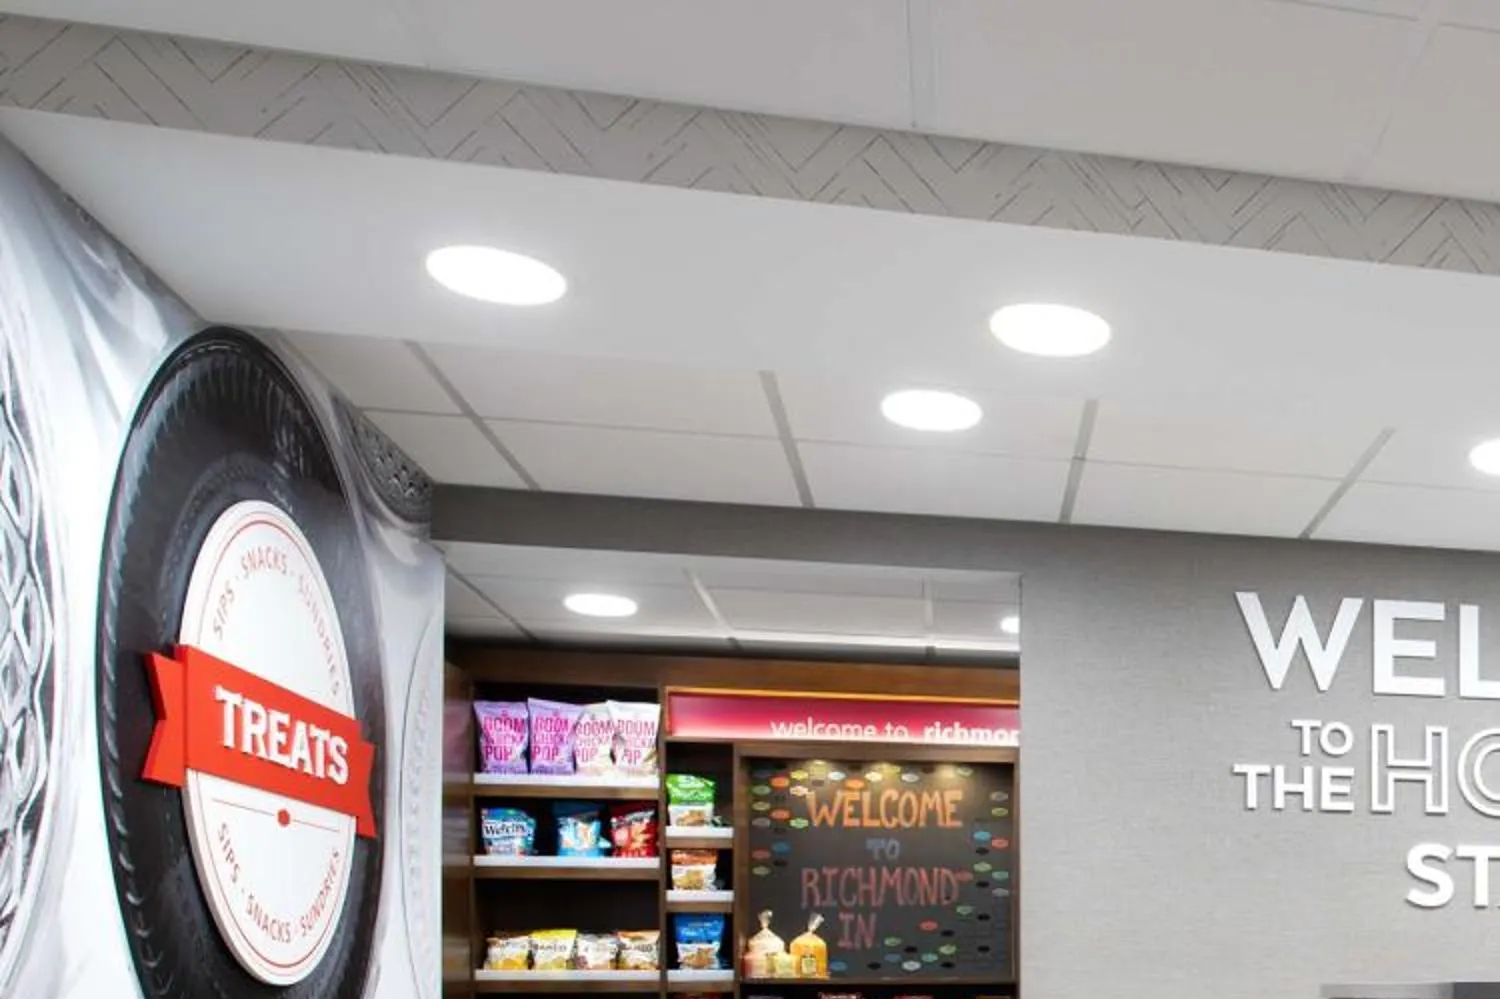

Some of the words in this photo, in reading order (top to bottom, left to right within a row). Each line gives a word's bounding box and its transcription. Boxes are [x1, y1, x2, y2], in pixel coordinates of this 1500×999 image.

[212, 578, 236, 642] SIPS
[240, 546, 289, 579] SNACKS
[213, 684, 349, 785] TREATS
[770, 716, 877, 740] welcome
[884, 722, 909, 742] to
[1291, 719, 1354, 756] TO
[1233, 764, 1355, 812] THE
[806, 790, 963, 829] WELCOME
[866, 838, 900, 860] TO
[217, 822, 241, 884] SIPS
[245, 894, 292, 944] SNACKS
[801, 866, 959, 909] RICHMOND
[838, 911, 877, 950] IN
